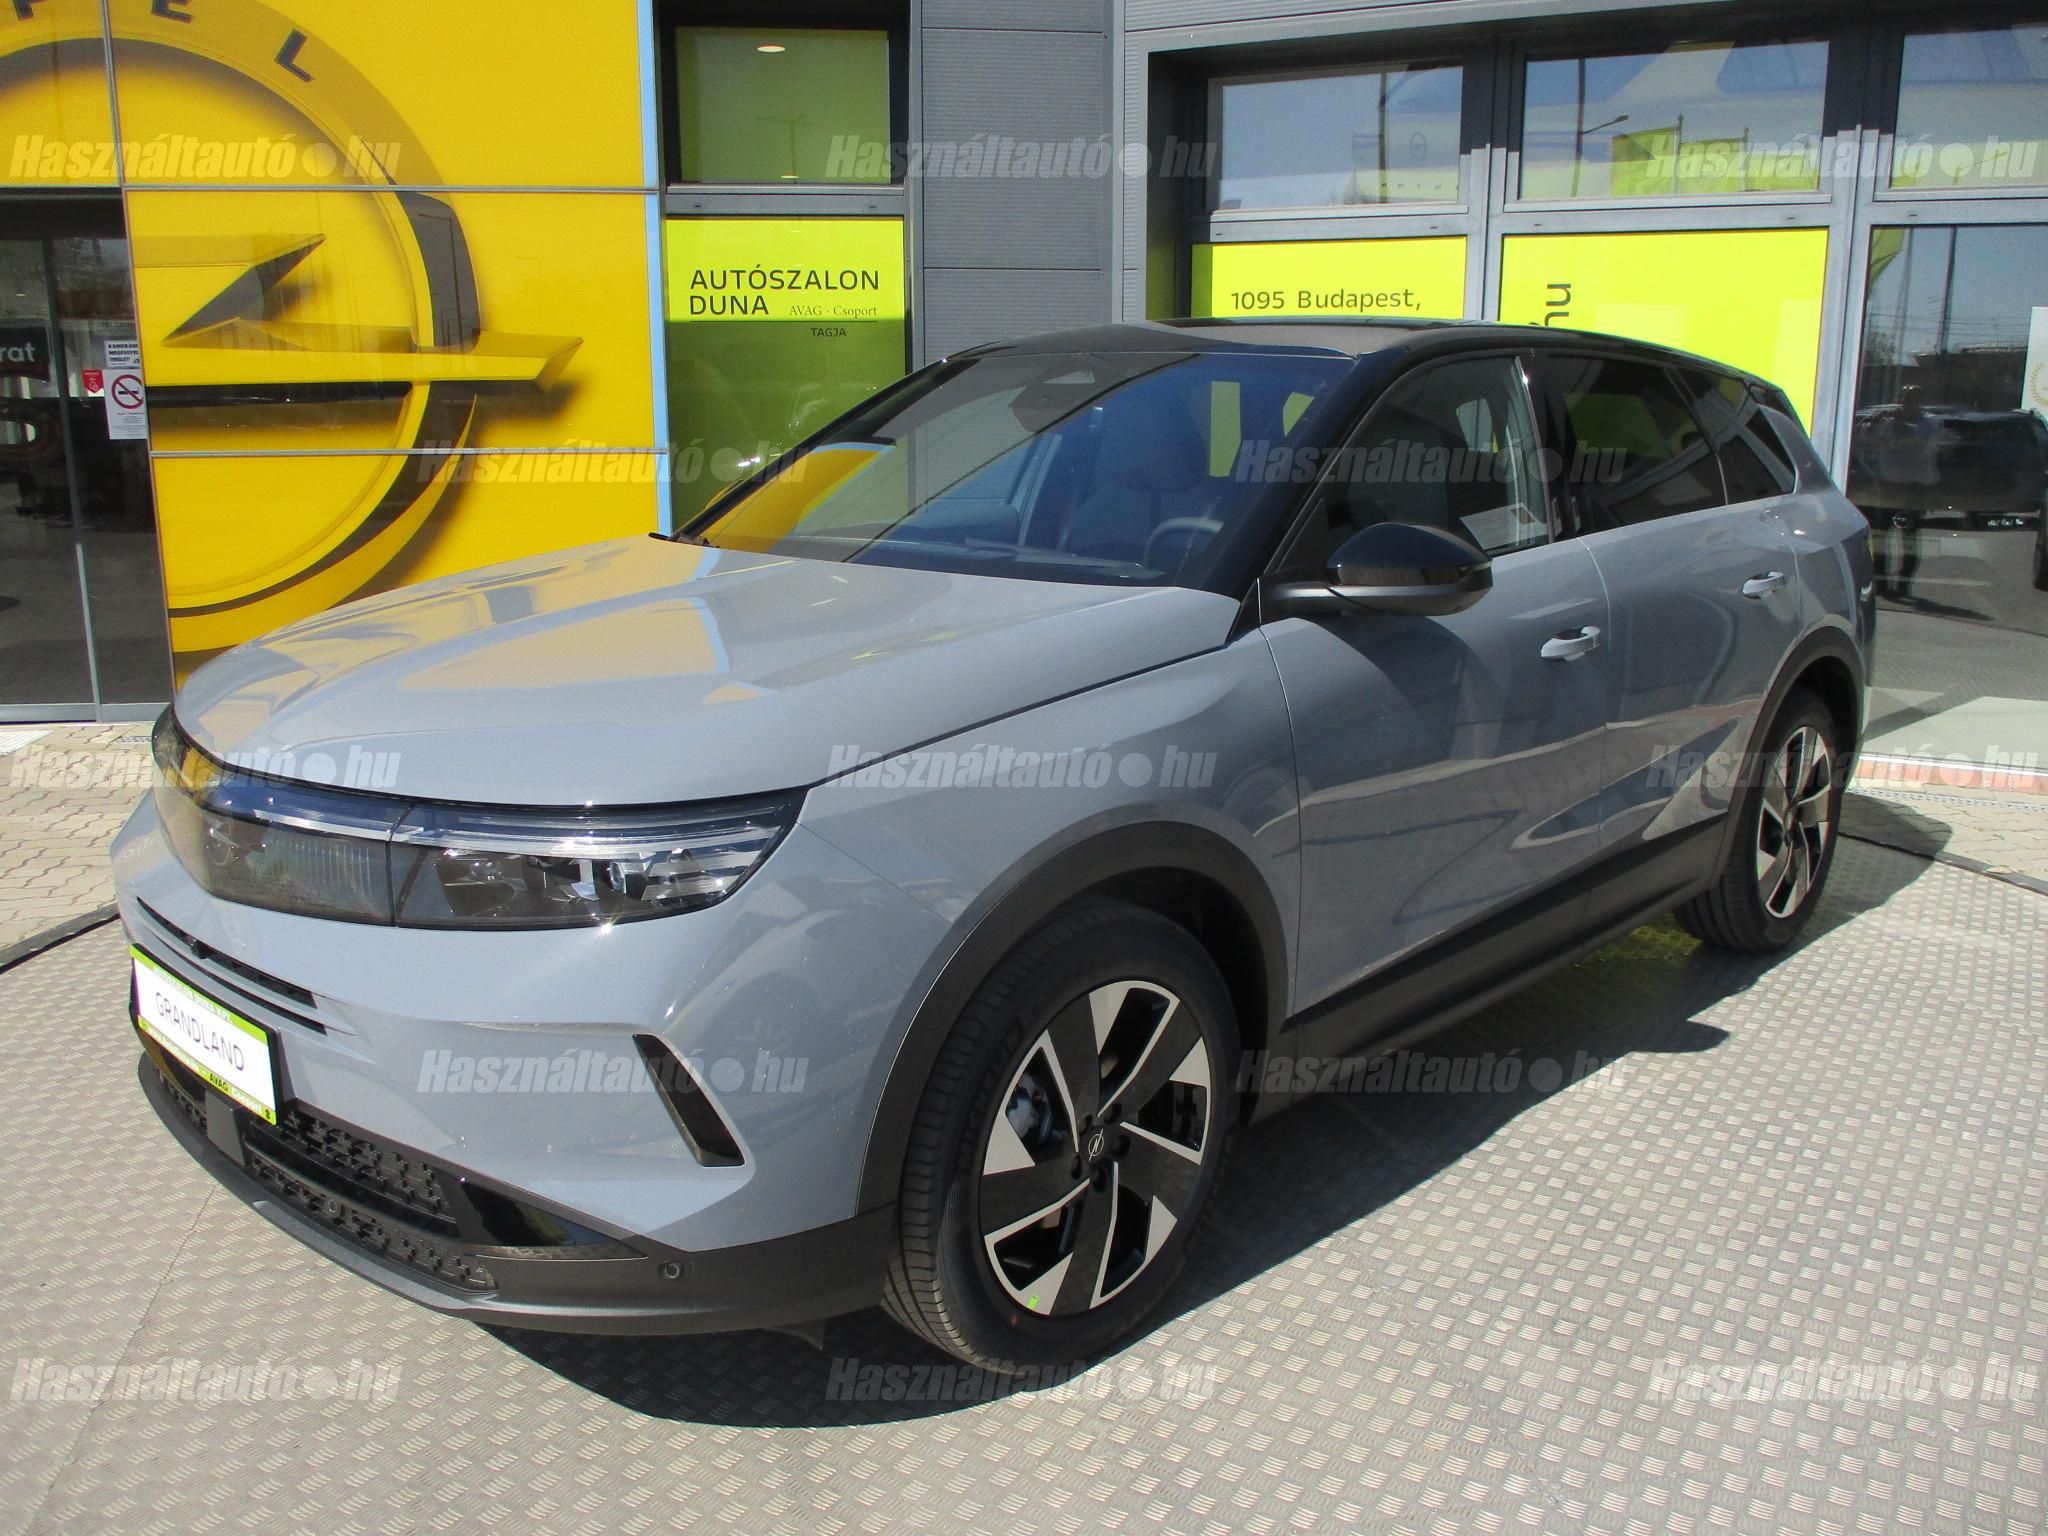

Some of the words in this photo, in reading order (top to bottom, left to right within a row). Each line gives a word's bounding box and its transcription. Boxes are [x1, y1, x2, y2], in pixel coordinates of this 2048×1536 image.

[690, 264, 879, 290] AUTÓSZALON
[689, 295, 769, 315] DUNA
[1231, 290, 1285, 310] 1095
[1297, 288, 1422, 313] Budapest,
[789, 305, 822, 316] AVAG
[833, 305, 878, 319] Csoport
[810, 327, 847, 338] TAGJA
[156, 991, 245, 1072] GRANDLAND
